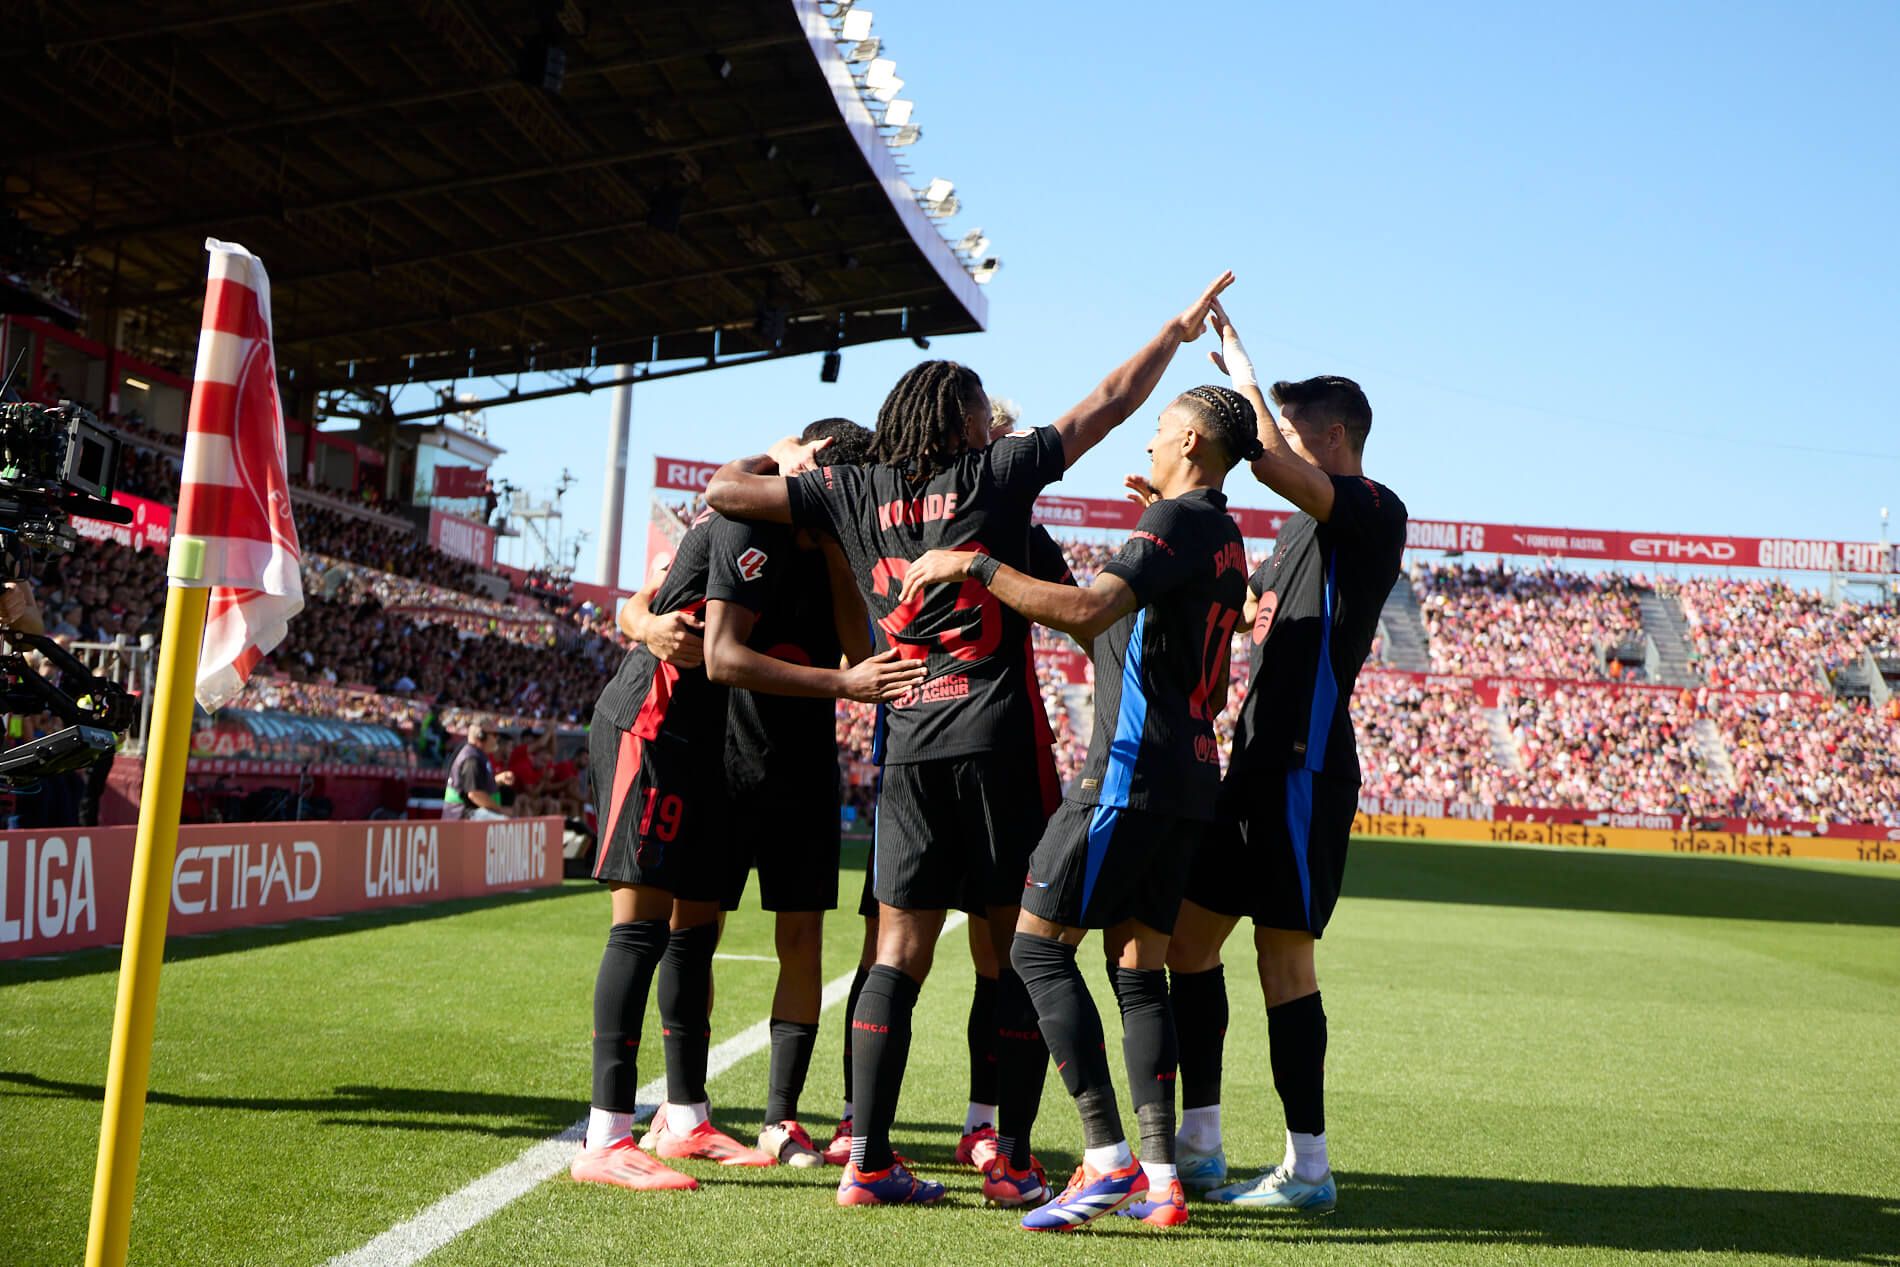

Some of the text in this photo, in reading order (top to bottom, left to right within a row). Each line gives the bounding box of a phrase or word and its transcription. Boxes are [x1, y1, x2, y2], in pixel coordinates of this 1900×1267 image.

[1460, 524, 1484, 550] FC
[1629, 538, 1736, 560] ETIHAD
[1758, 539, 1839, 570] GIRONA
[922, 683, 968, 698] ACNUR
[639, 787, 683, 842] 19
[1490, 820, 1607, 847] idealista
[1672, 832, 1792, 857] idealista
[366, 826, 439, 897] LALIGA
[485, 822, 546, 886] GIRONA FC
[0, 836, 97, 944] LIGA
[172, 841, 322, 915] ETIHAD
